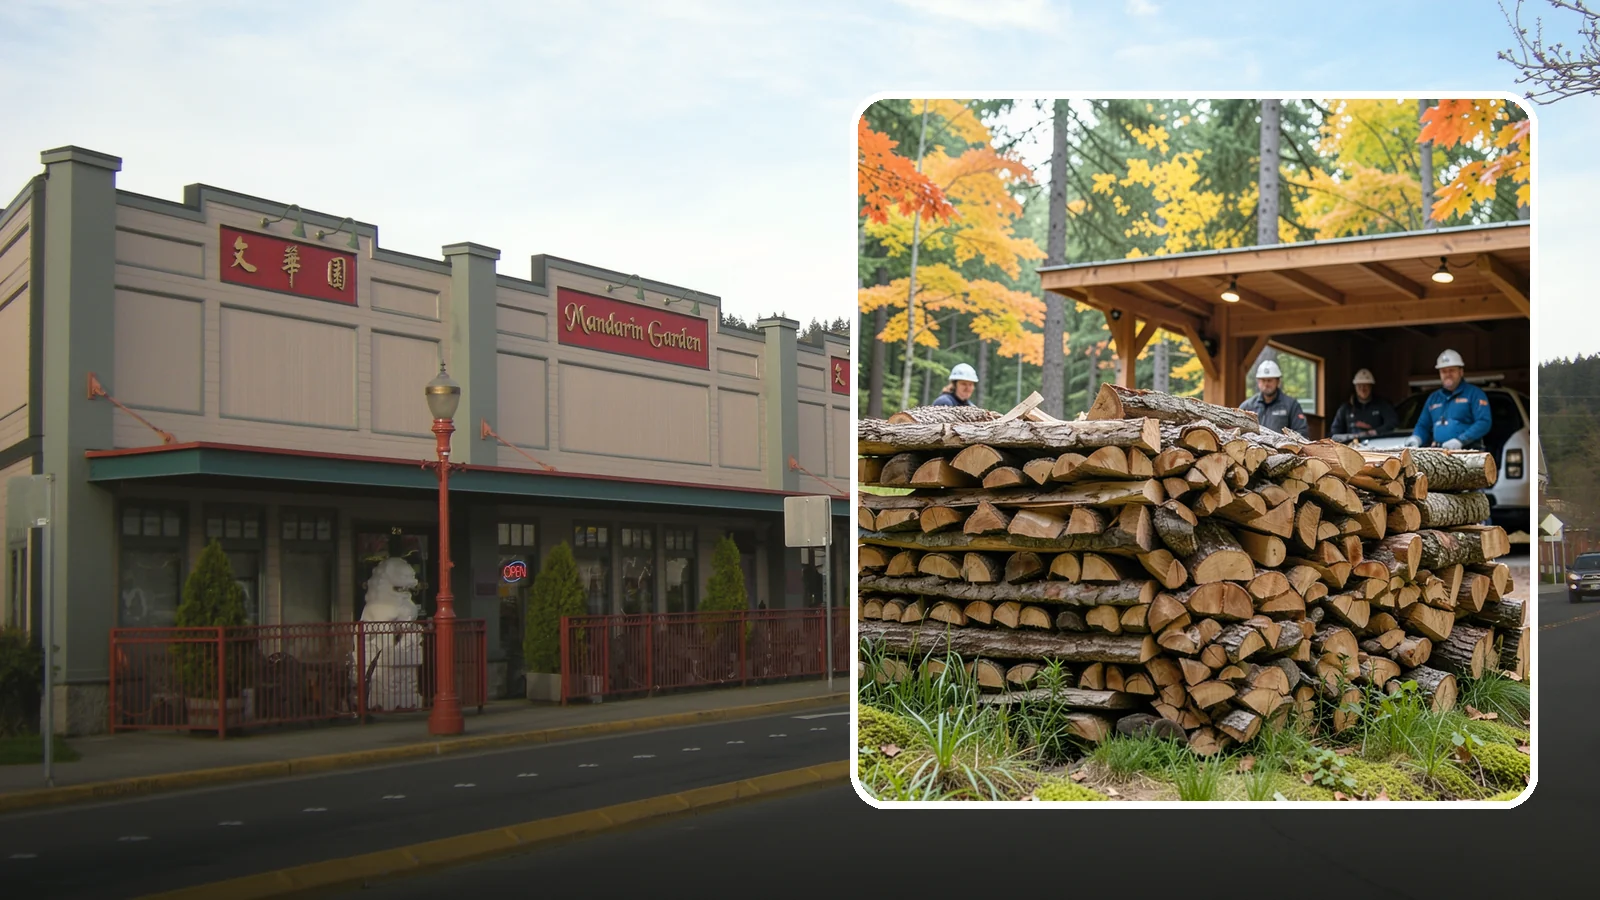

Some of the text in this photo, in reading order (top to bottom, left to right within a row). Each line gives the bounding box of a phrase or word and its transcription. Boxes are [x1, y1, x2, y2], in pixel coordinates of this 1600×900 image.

[231, 235, 346, 291] 文華園
[564, 302, 702, 352] Mandarin Garden
[834, 362, 846, 386] 文
[503, 565, 527, 578] OPEN
